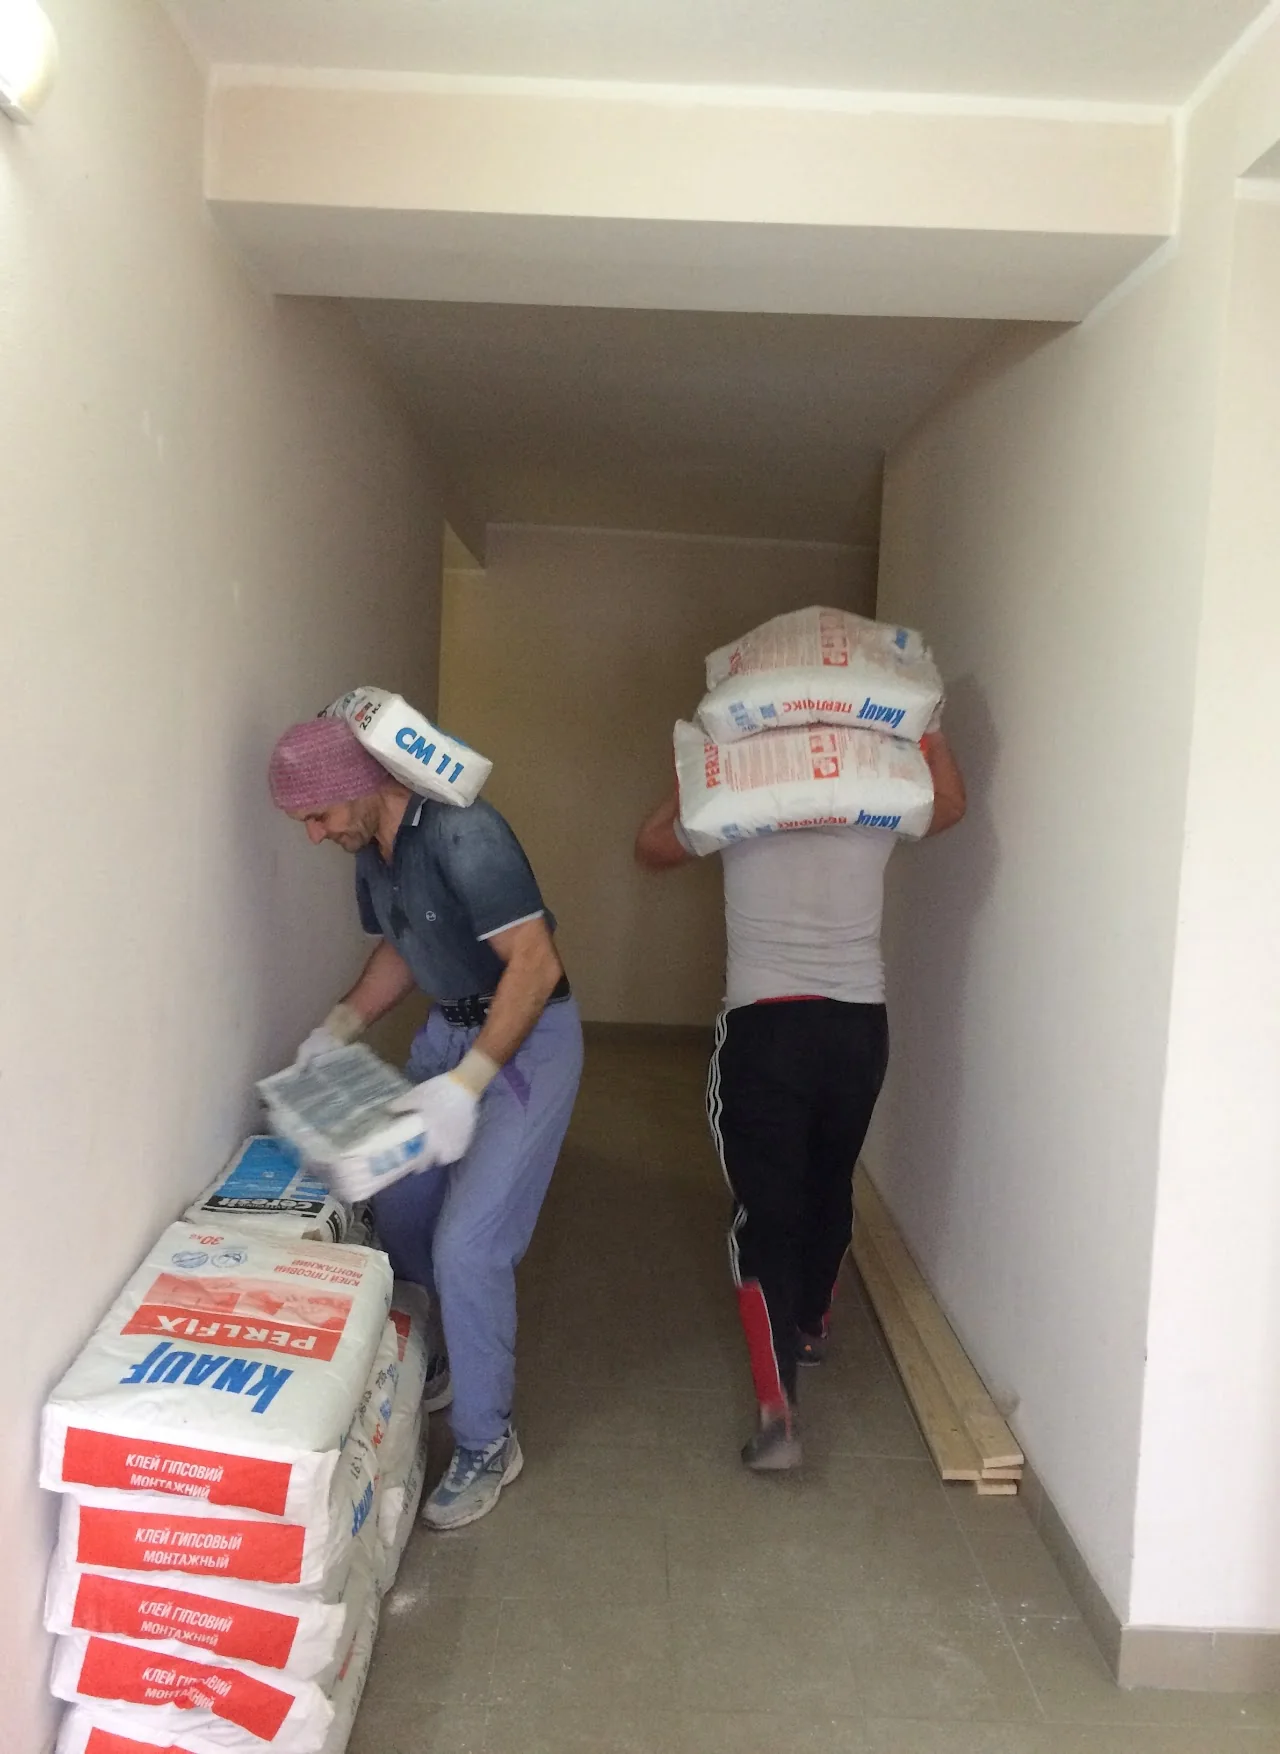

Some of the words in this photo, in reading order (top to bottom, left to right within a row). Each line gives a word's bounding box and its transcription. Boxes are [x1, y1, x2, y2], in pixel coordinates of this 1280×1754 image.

[359, 714, 372, 731] 25
[856, 697, 906, 728] KNAUF
[395, 726, 437, 766] CM
[434, 753, 465, 784] 11
[854, 809, 902, 830] KNAUF
[156, 1315, 317, 1352] PERLFIX
[119, 1342, 294, 1414] KNAUF
[126, 1453, 161, 1471] КЛЕЙ
[161, 1459, 224, 1482] ГІПСОВИЙ
[130, 1473, 211, 1498] МОНТАЖНИЙ
[135, 1527, 170, 1544] КЛЕЙ
[172, 1531, 243, 1551] ГИПСОВЫЙ
[143, 1550, 230, 1568] МОНТАЖНЫЙ
[138, 1600, 172, 1618] КЛЕЙ
[172, 1607, 233, 1632] ГІПСОВИЙ
[141, 1621, 219, 1646] МОНТАЖНИЙ
[142, 1667, 175, 1685] КЛЕЙ
